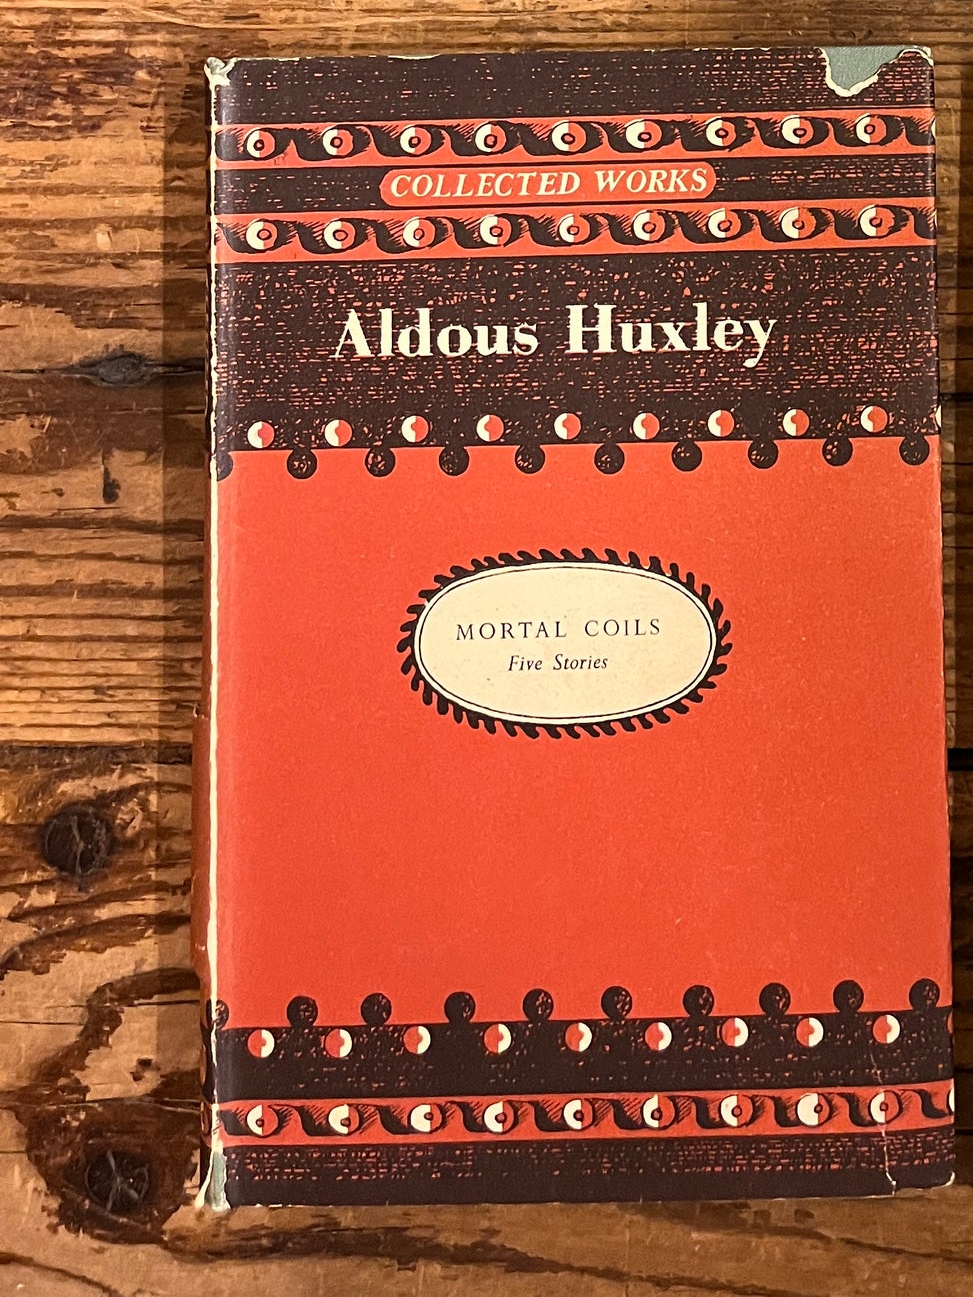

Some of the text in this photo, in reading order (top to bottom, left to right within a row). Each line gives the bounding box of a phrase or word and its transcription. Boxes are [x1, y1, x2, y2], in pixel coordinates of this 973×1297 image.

[390, 167, 707, 198] COLLECTED WORKS
[328, 301, 778, 368] Aldous Huxley
[455, 618, 660, 641] MORTAL COILS
[507, 653, 609, 672] Five Stories
